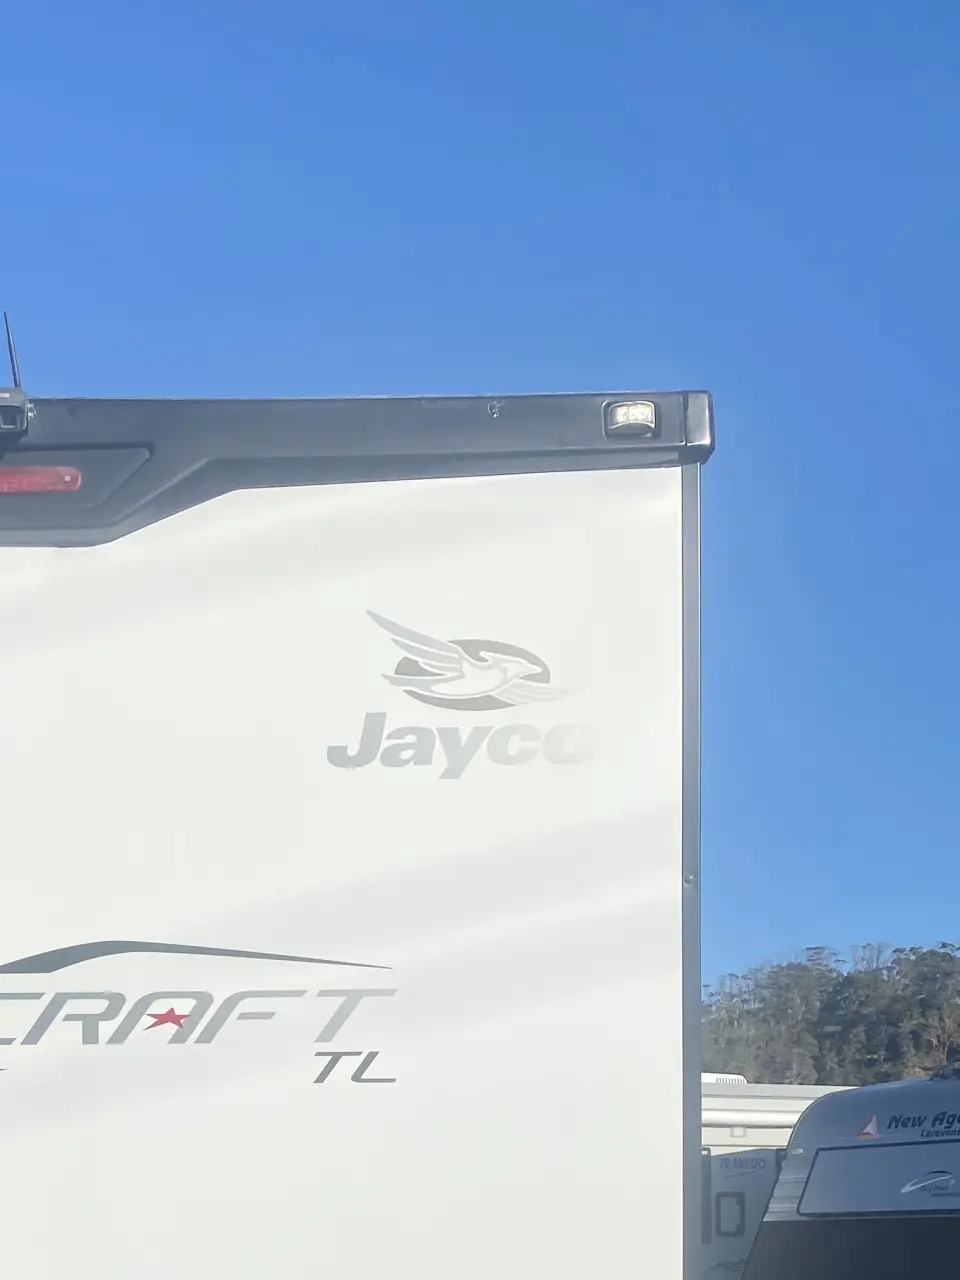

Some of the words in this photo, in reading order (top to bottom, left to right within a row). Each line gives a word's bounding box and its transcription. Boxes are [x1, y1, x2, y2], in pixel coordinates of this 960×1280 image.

[326, 711, 594, 780] Jayco
[313, 1050, 397, 1084] TL
[886, 1113, 927, 1130] New
